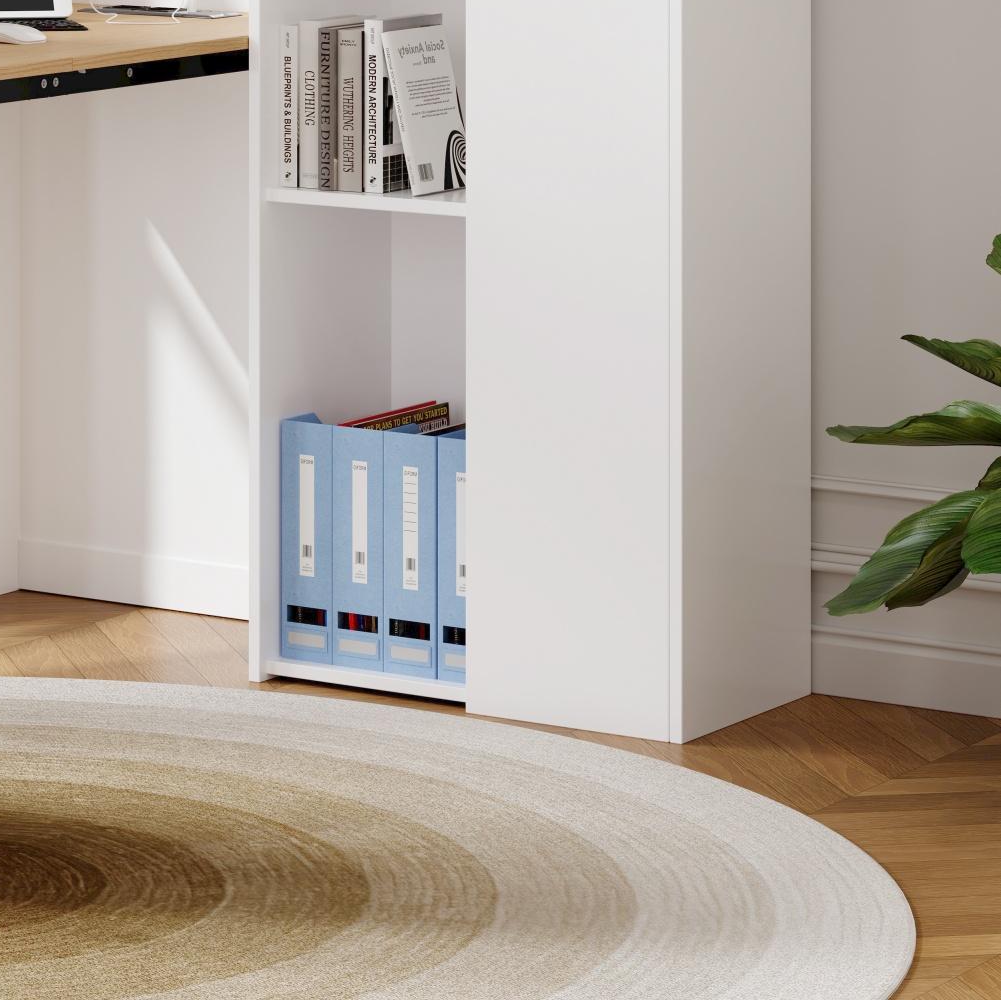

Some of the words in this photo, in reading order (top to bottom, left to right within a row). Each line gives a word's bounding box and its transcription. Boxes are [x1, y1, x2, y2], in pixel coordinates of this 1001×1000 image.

[284, 56, 292, 108] BLUEPRINTS
[304, 70, 315, 127] CLOTHING
[320, 31, 331, 125] FURNITURE
[368, 54, 377, 94] MODERN
[284, 110, 292, 118] &
[342, 77, 354, 131] WUTHERING
[284, 119, 292, 164] BUILDINGS
[342, 135, 354, 173] HEIGHTS
[368, 96, 377, 165] ARCHITECTURE
[320, 129, 331, 189] DESIGN
[394, 418, 401, 426] TO
[401, 416, 412, 424] GET
[413, 412, 424, 422] YOU
[425, 407, 448, 419] STARTED
